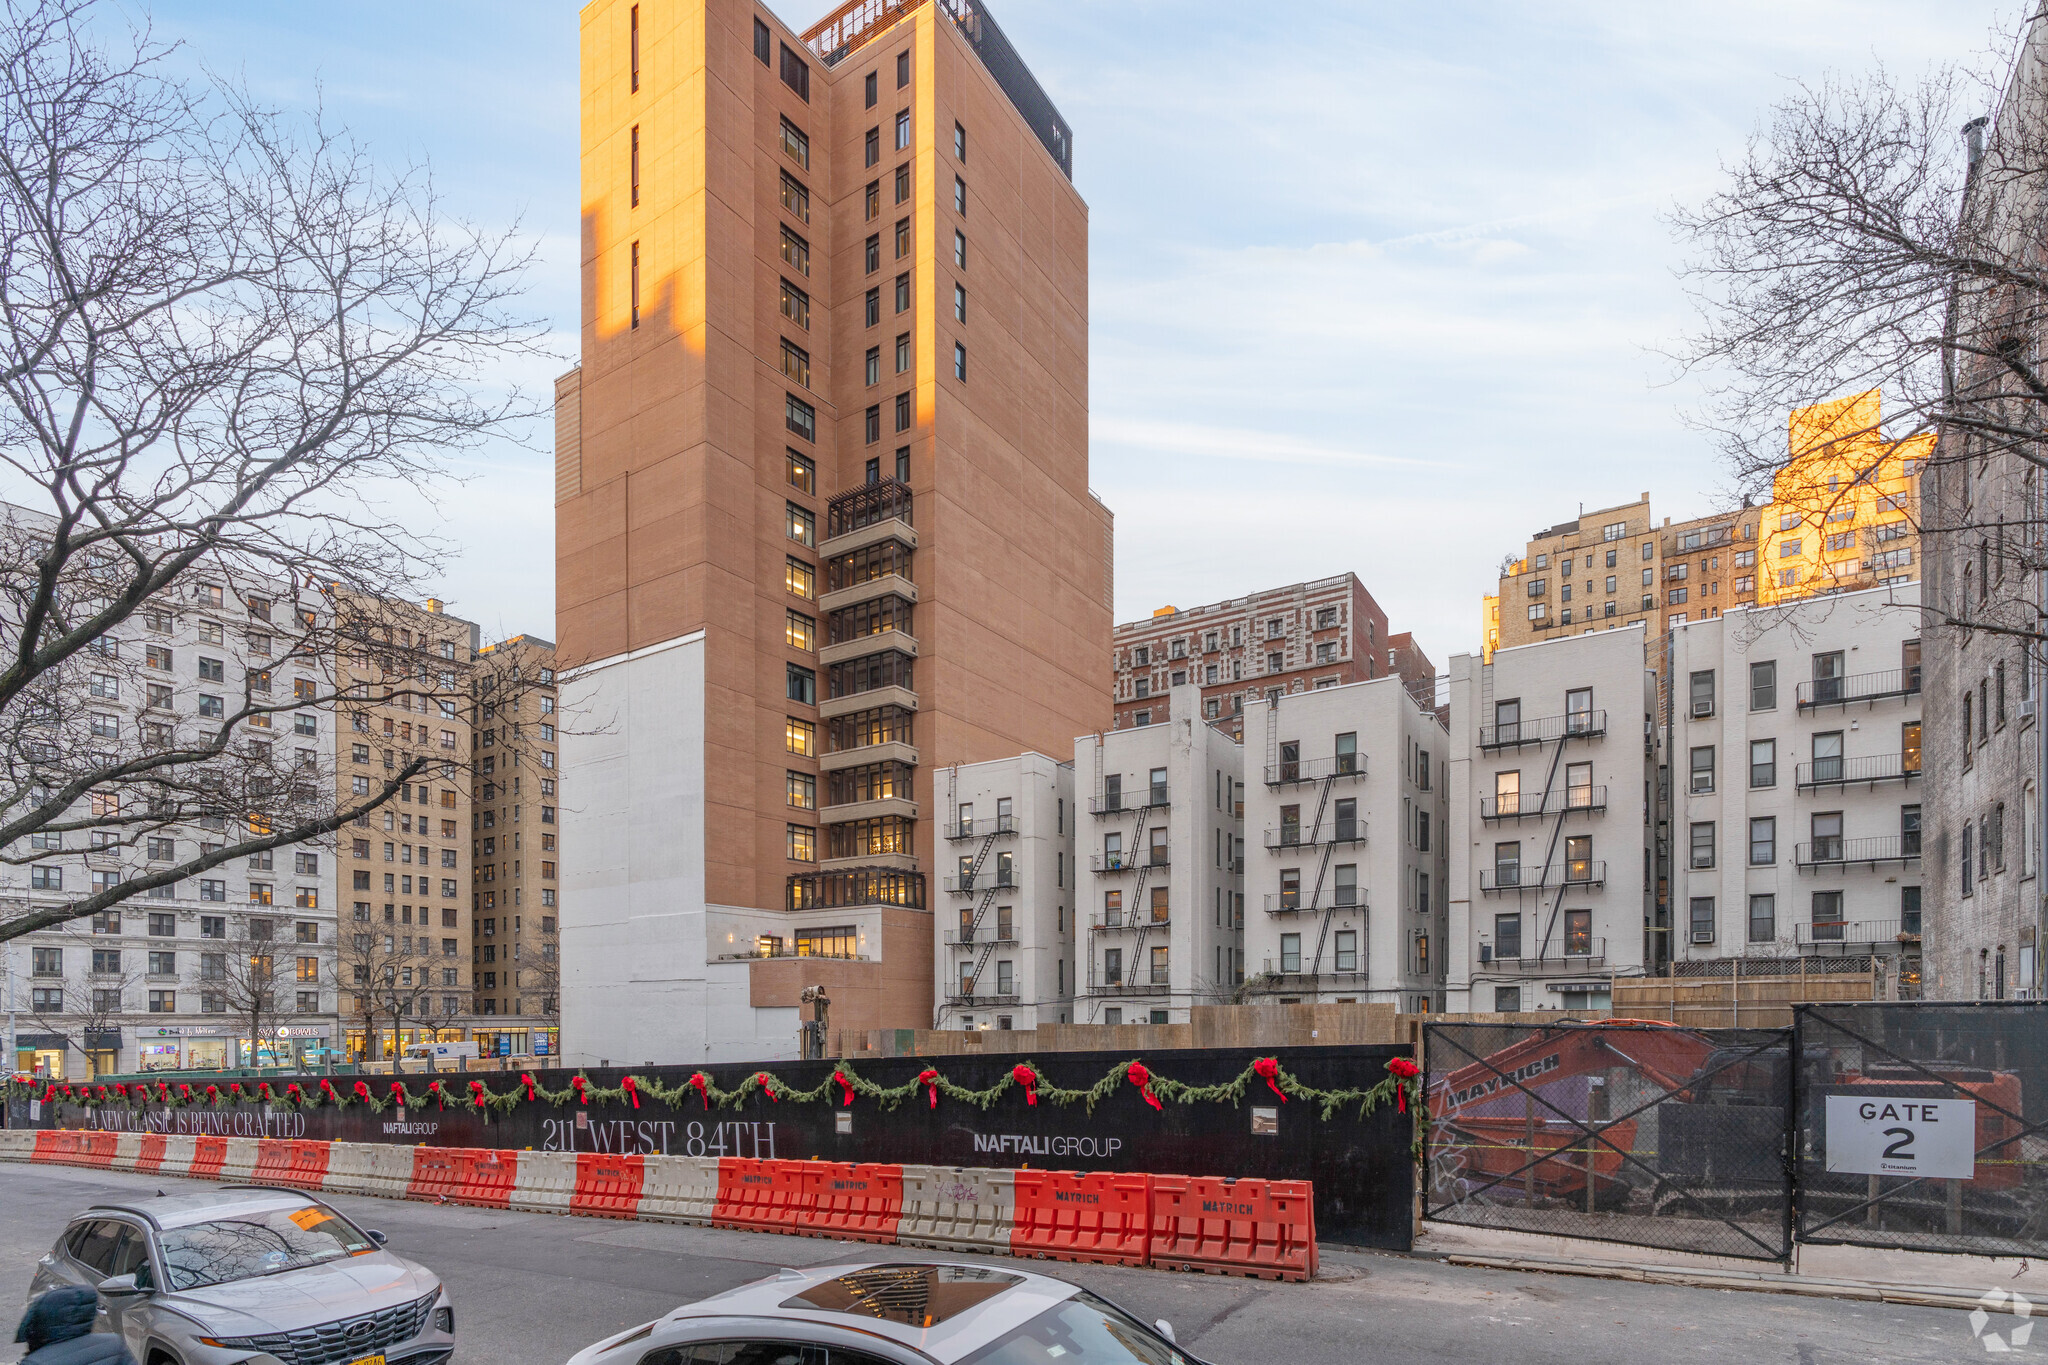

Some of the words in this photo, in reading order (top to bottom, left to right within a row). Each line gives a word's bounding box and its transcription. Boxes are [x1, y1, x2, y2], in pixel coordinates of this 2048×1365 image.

[289, 1028, 319, 1036] BOWLS
[1446, 1053, 1560, 1109] MAYRICH
[90, 1110, 98, 1129] A
[100, 1110, 124, 1131] NEW
[127, 1111, 173, 1133] CLASSIC
[177, 1112, 188, 1133] IS
[191, 1112, 230, 1135] BEING
[234, 1112, 305, 1137] CRAFTED
[1859, 1103, 1939, 1122] GATE
[543, 1118, 577, 1151] 211
[587, 1120, 675, 1155] WEST
[686, 1121, 776, 1158] 84TH
[1882, 1127, 1915, 1160] 2
[1056, 1191, 1099, 1204] MAYRICH
[1203, 1200, 1253, 1215] MAYRICH
